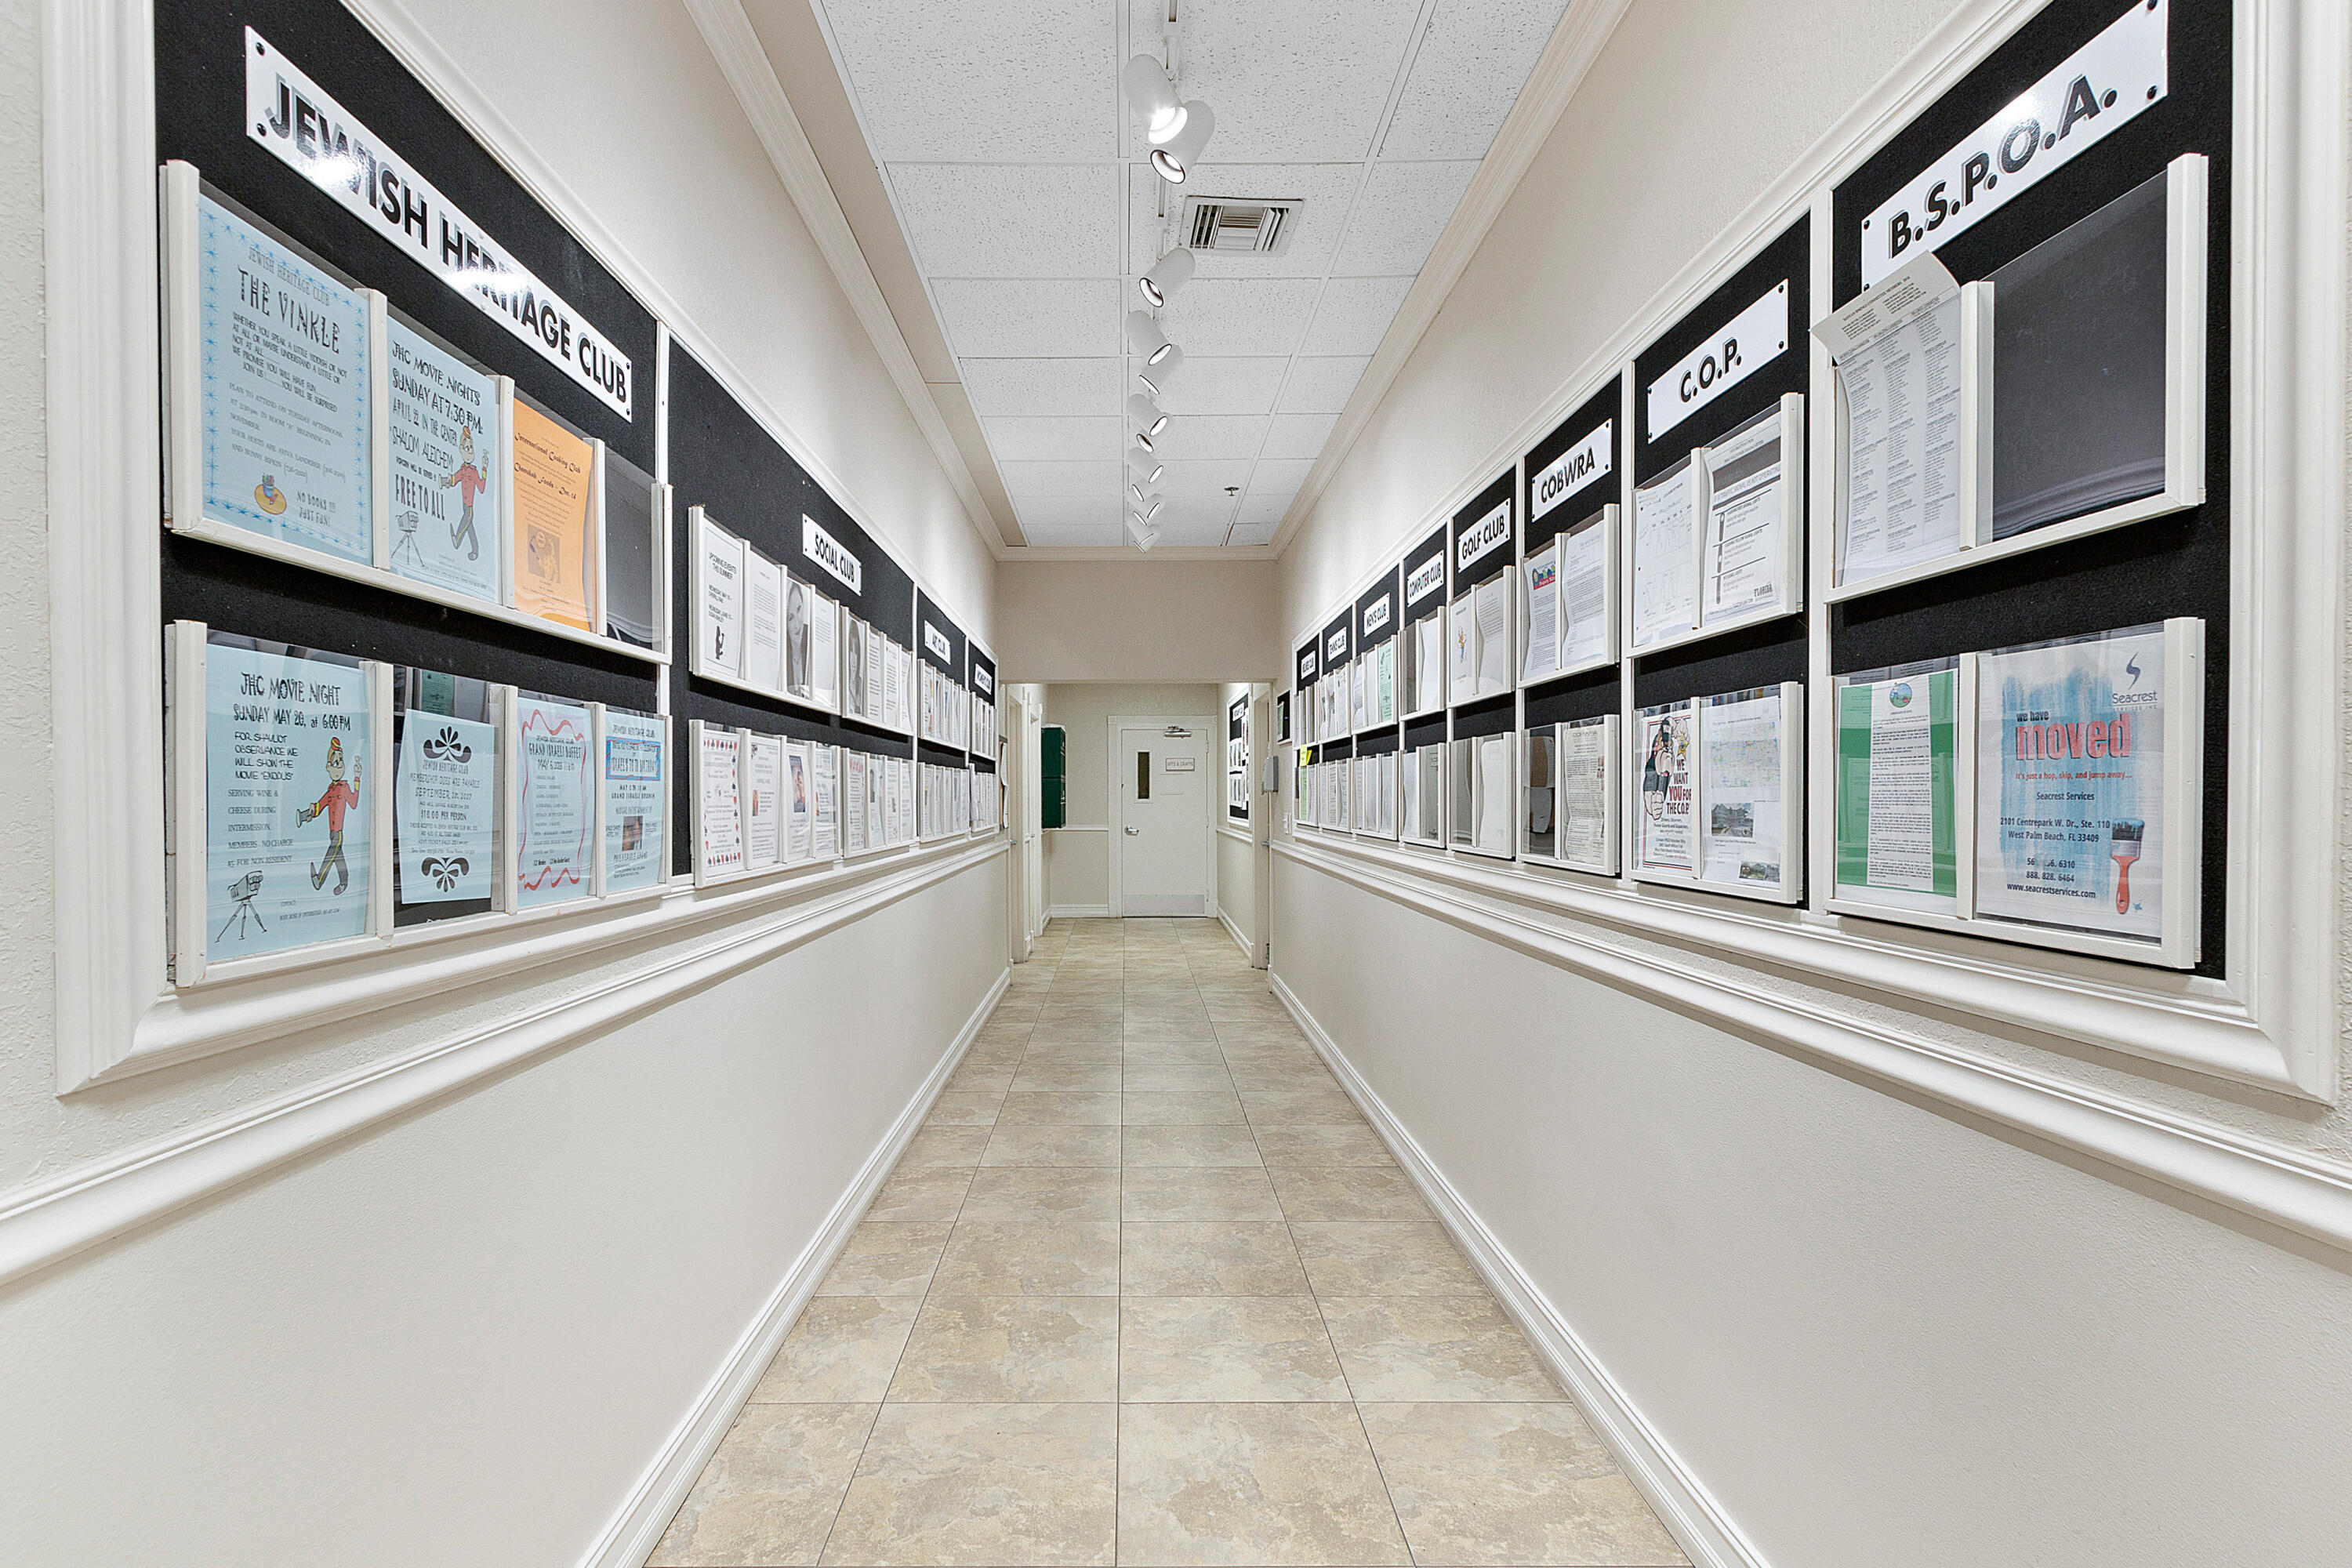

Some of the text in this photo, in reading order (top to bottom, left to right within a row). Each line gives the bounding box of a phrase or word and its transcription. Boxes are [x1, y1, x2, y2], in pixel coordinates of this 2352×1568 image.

[1889, 74, 2117, 259] B.S.P.O.A.
[266, 78, 428, 249] JEWISH
[579, 334, 626, 403] CLUB
[249, 247, 330, 307] JEWISH HERITAGE CLUB
[238, 263, 340, 354] THE VINKLE
[232, 311, 257, 330] WHETHER
[259, 325, 269, 338] YOU
[271, 332, 286, 347] SPEAK
[294, 343, 307, 357] LITTLE
[328, 363, 336, 372] OR
[338, 365, 347, 379] NOT
[266, 361, 277, 374] YOU
[279, 368, 290, 381] WILL
[292, 374, 305, 387] HAVE
[318, 368, 332, 380] LITTLE
[392, 340, 481, 406] JHC MOVIE NIGHTS
[1679, 337, 1742, 403] C.O.P.
[294, 385, 305, 397] WILL
[314, 394, 338, 413] SURPRISED
[392, 368, 431, 406] SUNDAY
[431, 392, 445, 414] AT
[445, 399, 466, 426] 7:30
[393, 397, 412, 423] APRIL
[514, 432, 548, 456] International
[549, 451, 568, 470] Cooking
[568, 463, 581, 474] Club
[1541, 447, 1595, 503] COBWRA
[395, 474, 445, 521] FREE TO ALL
[1461, 514, 1505, 560] GOLF CLUB
[815, 533, 855, 583] SOCIAL CLUB
[1430, 561, 1442, 583] CLUB
[240, 671, 341, 706] JHC MOVIE NIGHT
[2112, 691, 2158, 704] Seacrest
[233, 703, 270, 724] SUNDAY
[274, 708, 292, 726] MAY
[2016, 710, 2049, 722] we have
[234, 731, 252, 742] FOR
[2016, 713, 2132, 760] moved
[234, 745, 299, 757] OBSERVANCE WE
[234, 758, 294, 768] WILL SHOW THE
[1676, 758, 1685, 771] WE
[235, 771, 259, 780] MOVIE
[1673, 772, 1689, 785] WANT
[2026, 772, 2038, 781] just
[2089, 771, 2106, 780] jump
[227, 789, 254, 797] SERVING
[256, 789, 272, 797] WINE
[1668, 786, 1682, 801] YOU
[2036, 792, 2095, 800] Seacrest Services
[254, 806, 276, 815] DURING
[1666, 802, 1677, 815] THE
[2000, 817, 2015, 826] 2101
[2016, 818, 2053, 829] Centrepark
[2081, 819, 2095, 828] Ste.
[2096, 820, 2111, 829] 110
[2008, 830, 2100, 842] West Palm Beach, FL 33409
[2058, 859, 2075, 869] 6310
[2057, 873, 2075, 882] 6464
[2006, 883, 2096, 898] www.seacrestservices.com
